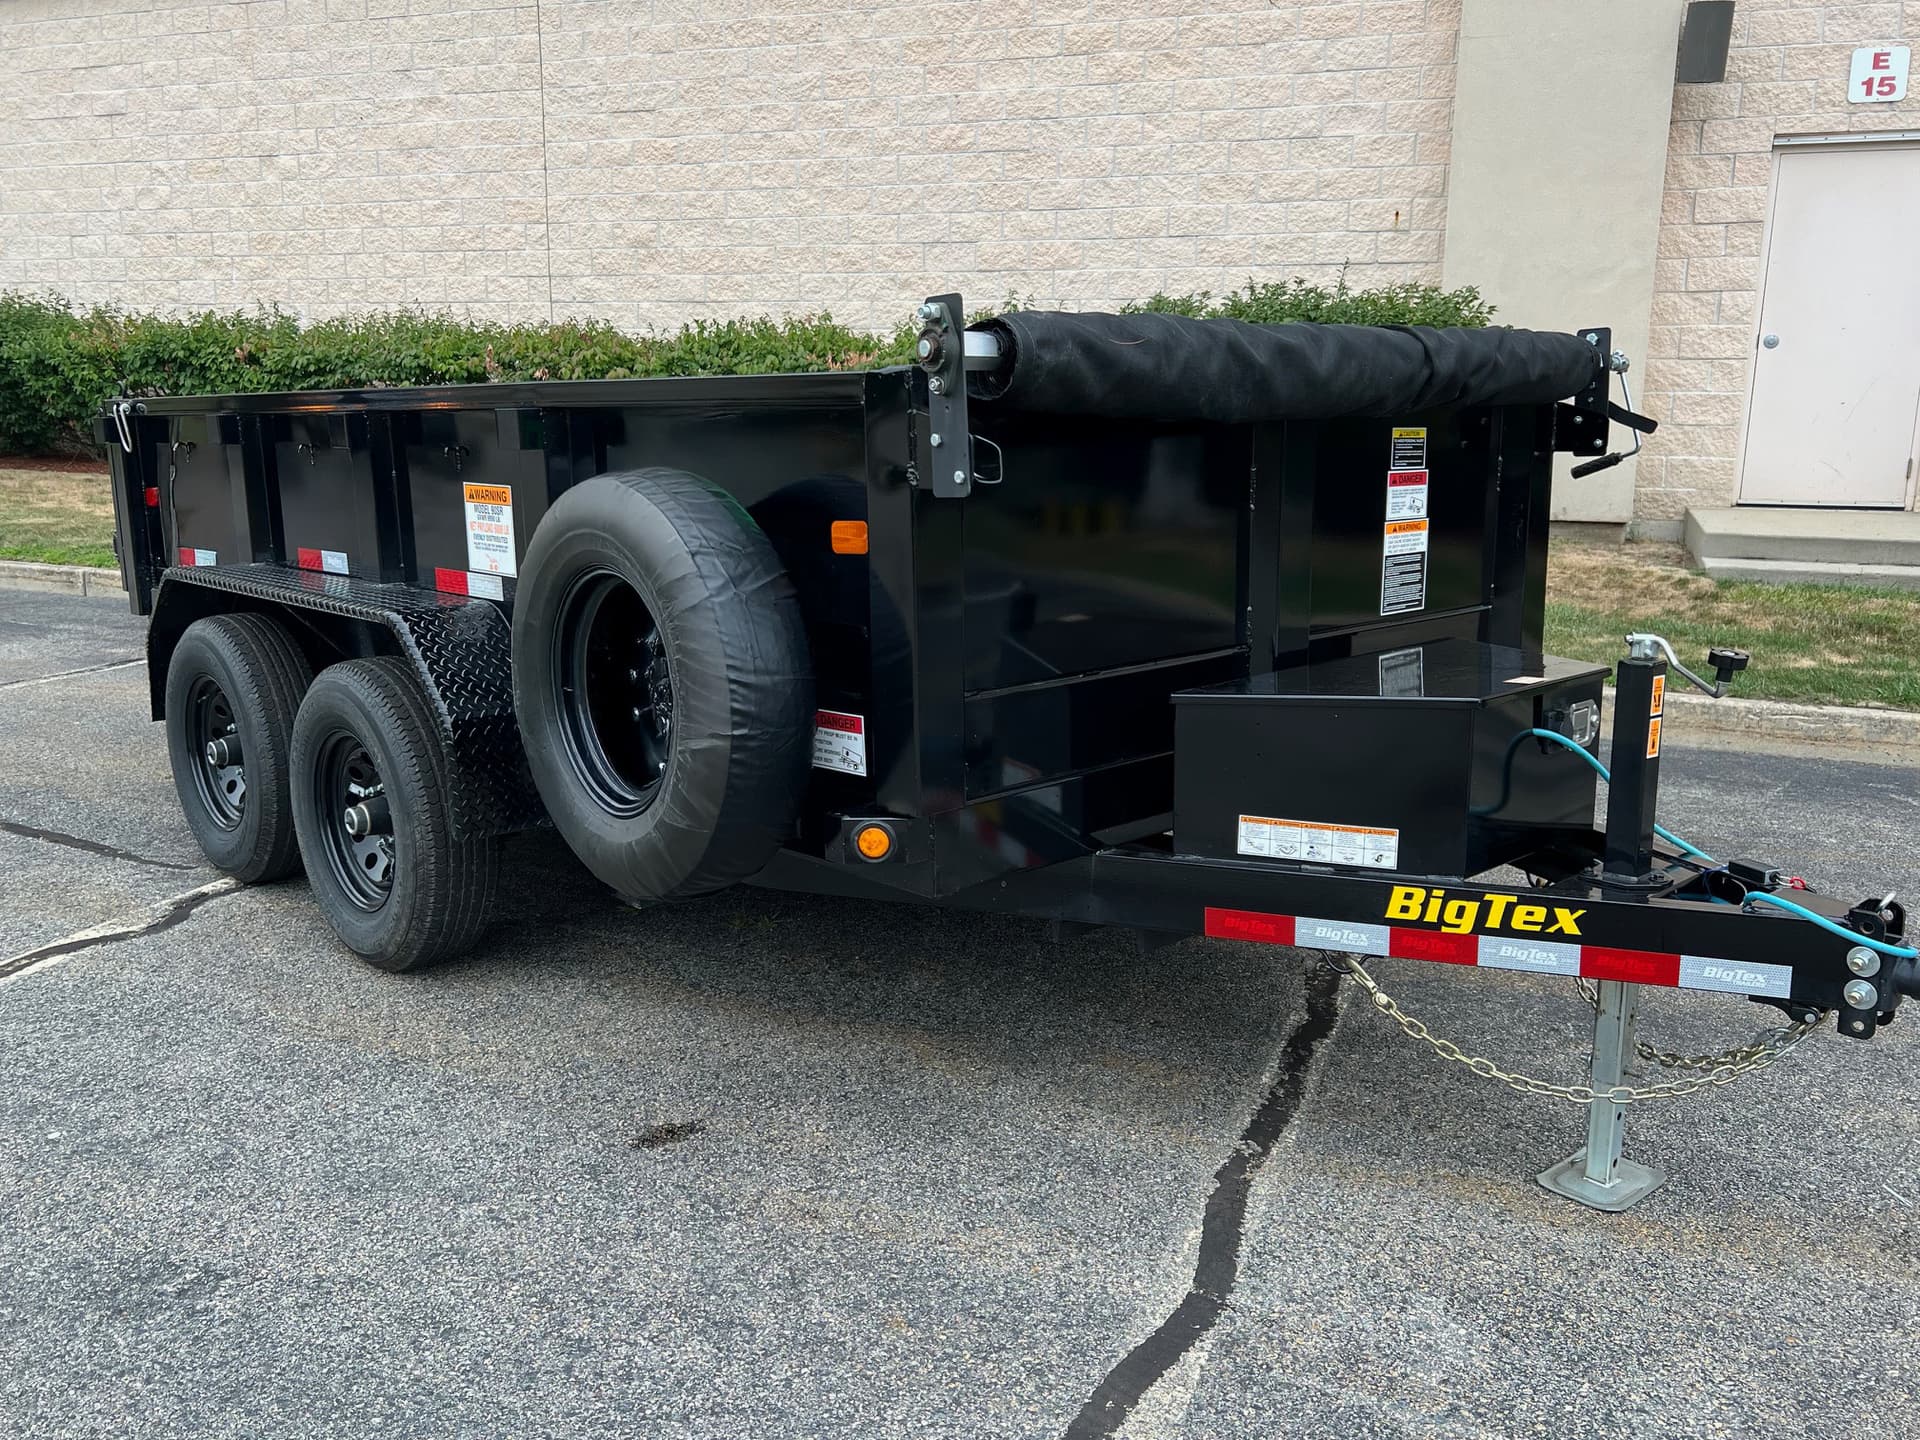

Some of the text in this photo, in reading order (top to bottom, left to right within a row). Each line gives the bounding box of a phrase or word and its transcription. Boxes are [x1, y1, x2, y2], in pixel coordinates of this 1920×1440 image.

[1872, 52, 1891, 70] E
[1861, 76, 1896, 96] 15
[474, 488, 507, 503] WARNING
[473, 504, 490, 514] MODEL
[1398, 523, 1422, 532] WARNING
[820, 715, 856, 729] DANGER
[1385, 886, 1587, 936] BigTex
[1314, 926, 1369, 942] BigTex
[1499, 945, 1558, 961] BigTex
[1702, 966, 1768, 982] BigTex
